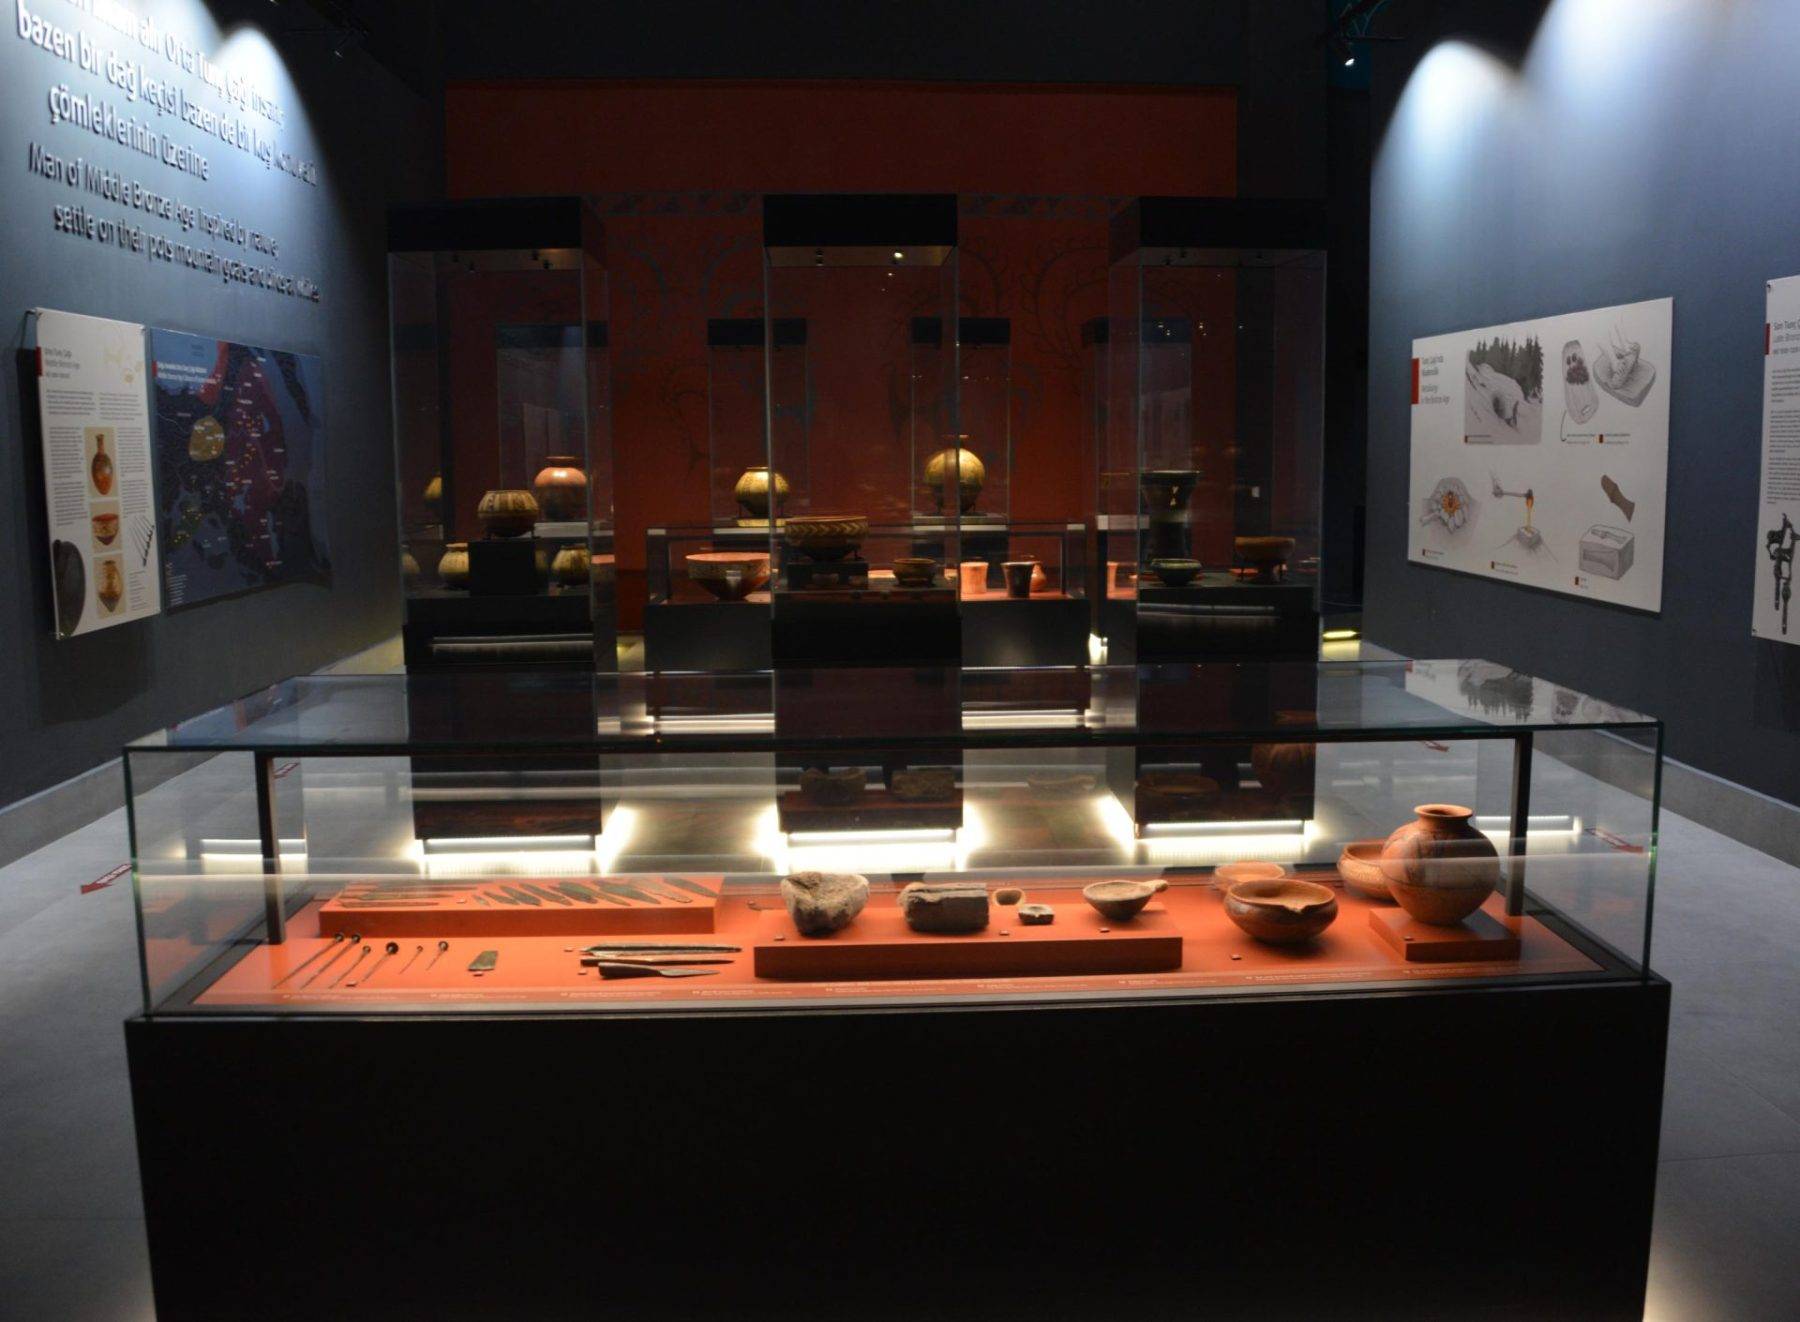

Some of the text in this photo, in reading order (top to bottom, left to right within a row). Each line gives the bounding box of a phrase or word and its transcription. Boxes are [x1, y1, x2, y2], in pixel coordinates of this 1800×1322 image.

[15, 0, 76, 63] bazen
[78, 30, 102, 76] bir
[106, 48, 136, 102] dağ
[137, 64, 177, 117] keçisi
[180, 88, 217, 137] bazen
[218, 113, 234, 146] de
[47, 83, 210, 182] çömleklerinin üzerine
[28, 141, 63, 183] Man
[66, 157, 83, 188] of
[84, 162, 130, 207] Middle
[131, 180, 172, 221] Bronze
[173, 198, 195, 232] Age
[236, 219, 248, 253] by
[53, 204, 95, 241] settle
[97, 218, 115, 245] on
[117, 218, 146, 254] their
[148, 233, 174, 265] pots
[174, 244, 220, 276] mountain
